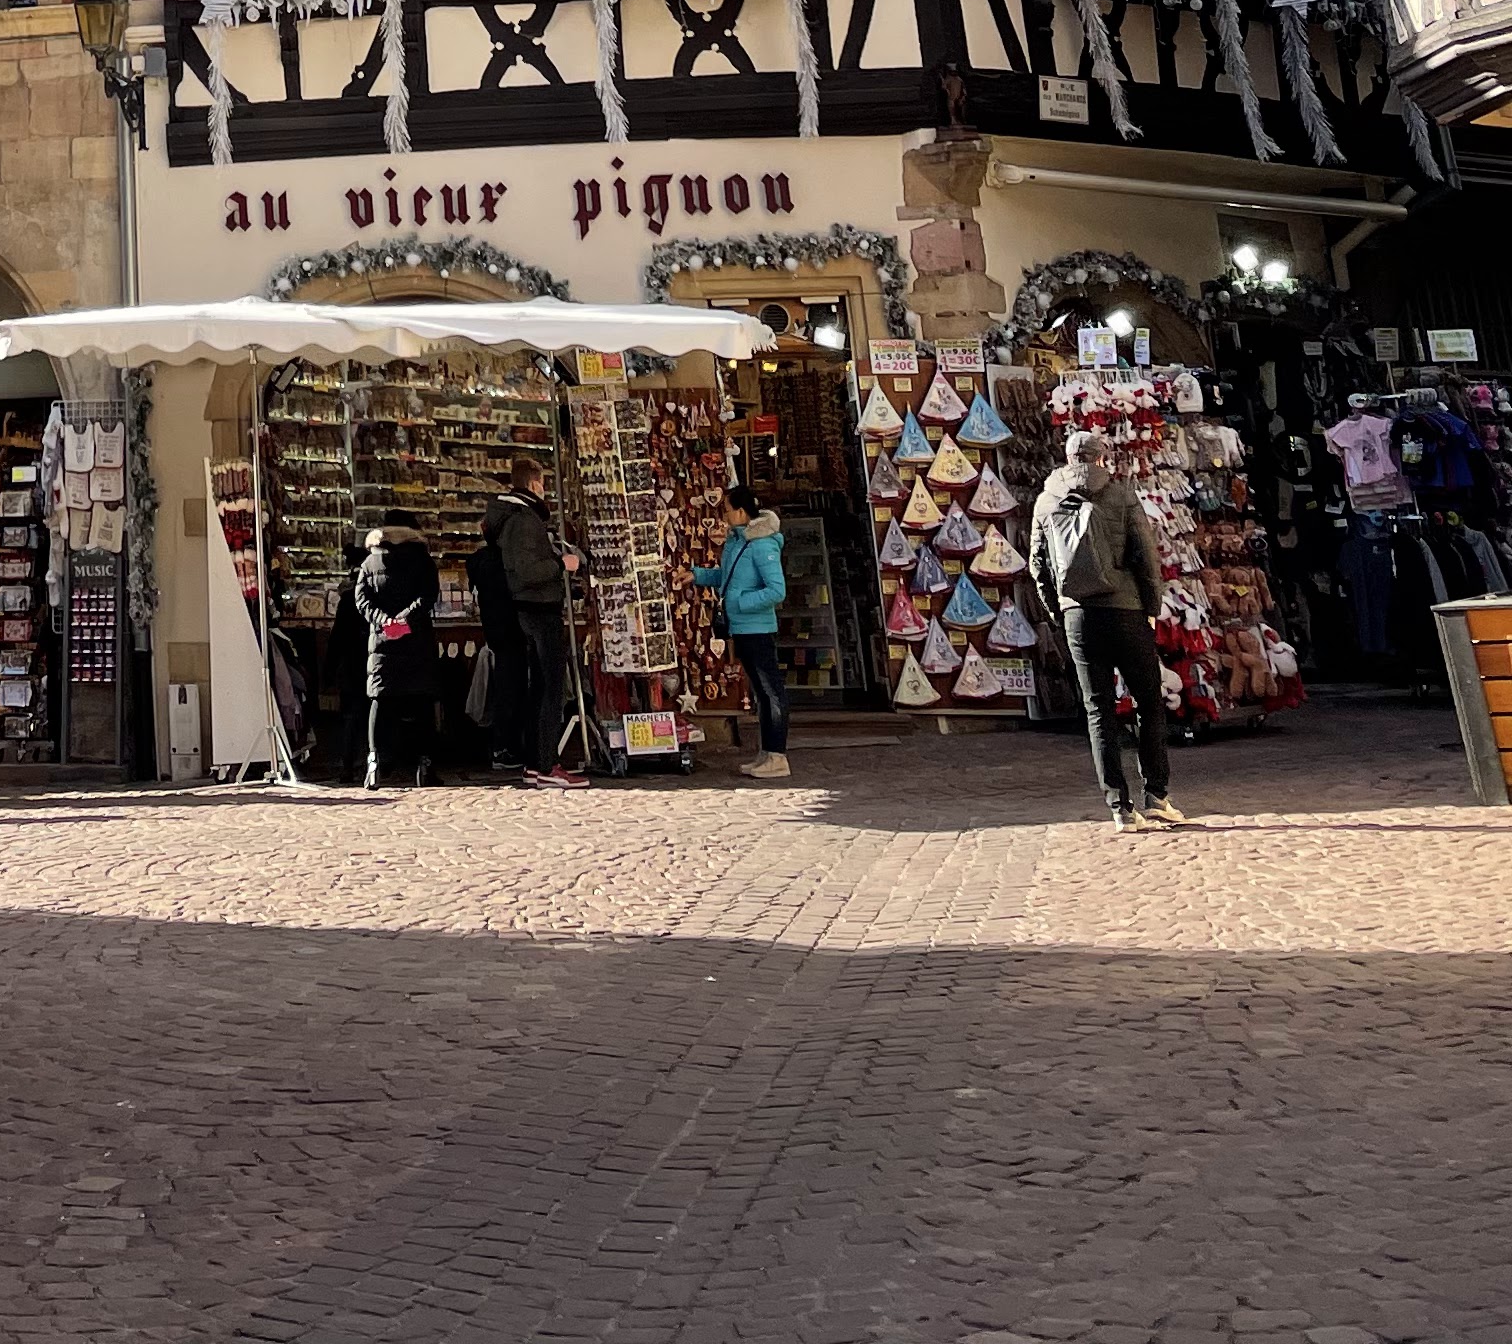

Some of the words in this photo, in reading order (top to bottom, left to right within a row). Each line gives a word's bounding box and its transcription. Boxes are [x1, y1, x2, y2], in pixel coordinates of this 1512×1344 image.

[224, 186, 291, 232] au
[345, 167, 508, 229] vieux
[572, 156, 796, 240] pignon
[73, 564, 114, 578] MUSIC
[626, 713, 671, 723] MAGNETS
